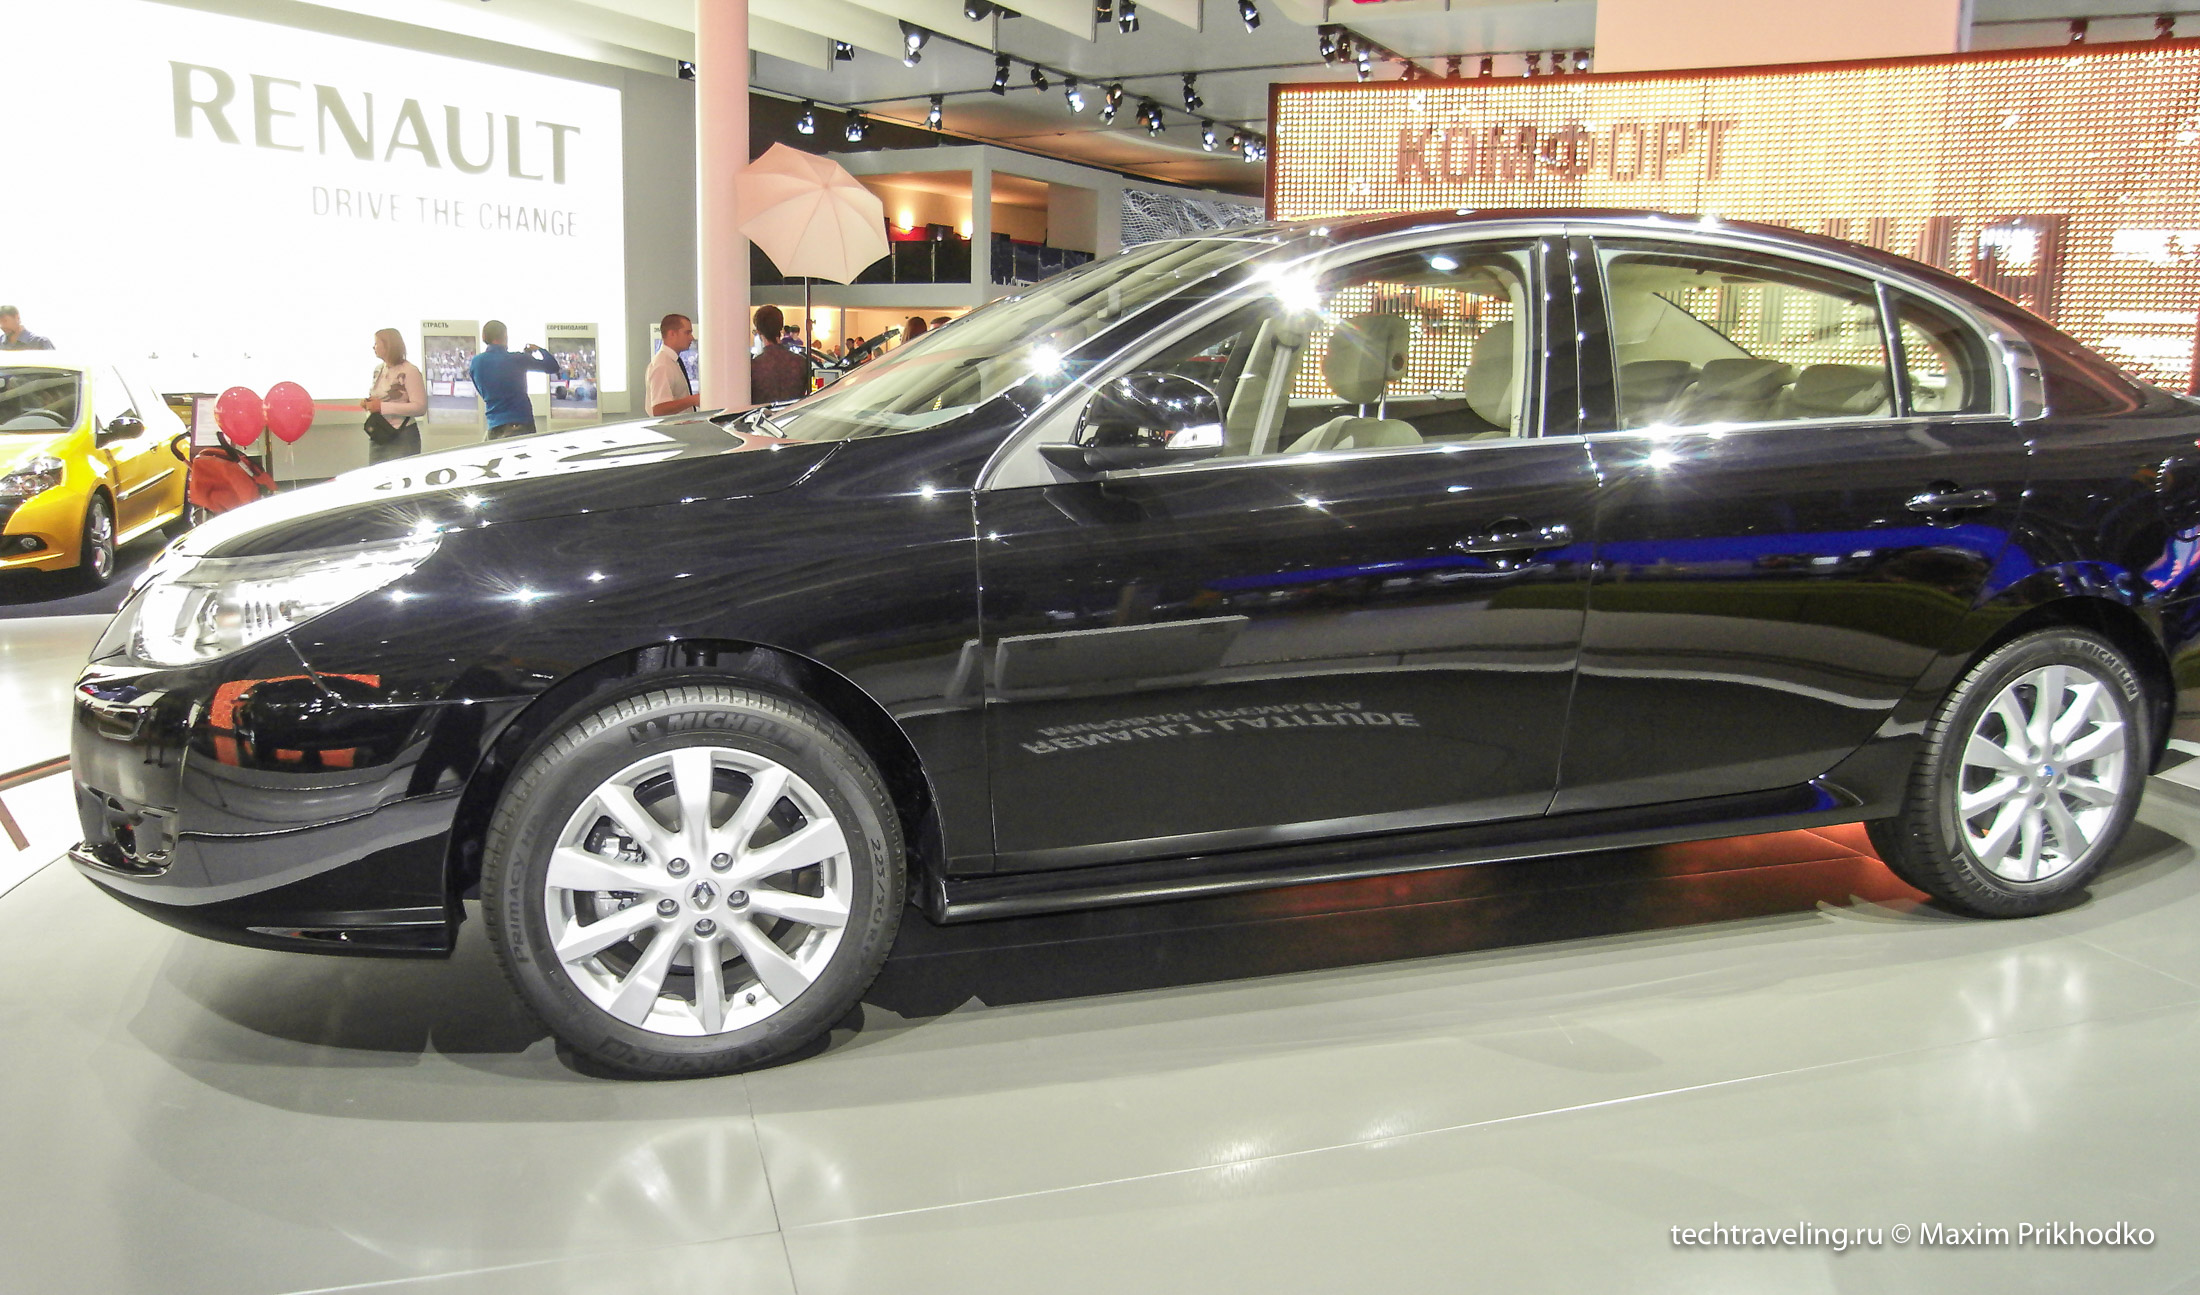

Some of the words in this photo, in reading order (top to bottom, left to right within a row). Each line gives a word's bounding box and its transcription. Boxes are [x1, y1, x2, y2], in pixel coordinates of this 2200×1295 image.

[168, 60, 581, 185] RENAULT
[1399, 118, 1738, 184] КОМФОРТ
[312, 186, 400, 222] DRIVE
[416, 197, 465, 228] THE
[479, 203, 577, 238] CHANGE
[2080, 641, 2140, 702] MICHELIN
[667, 711, 811, 748] MICHELIN
